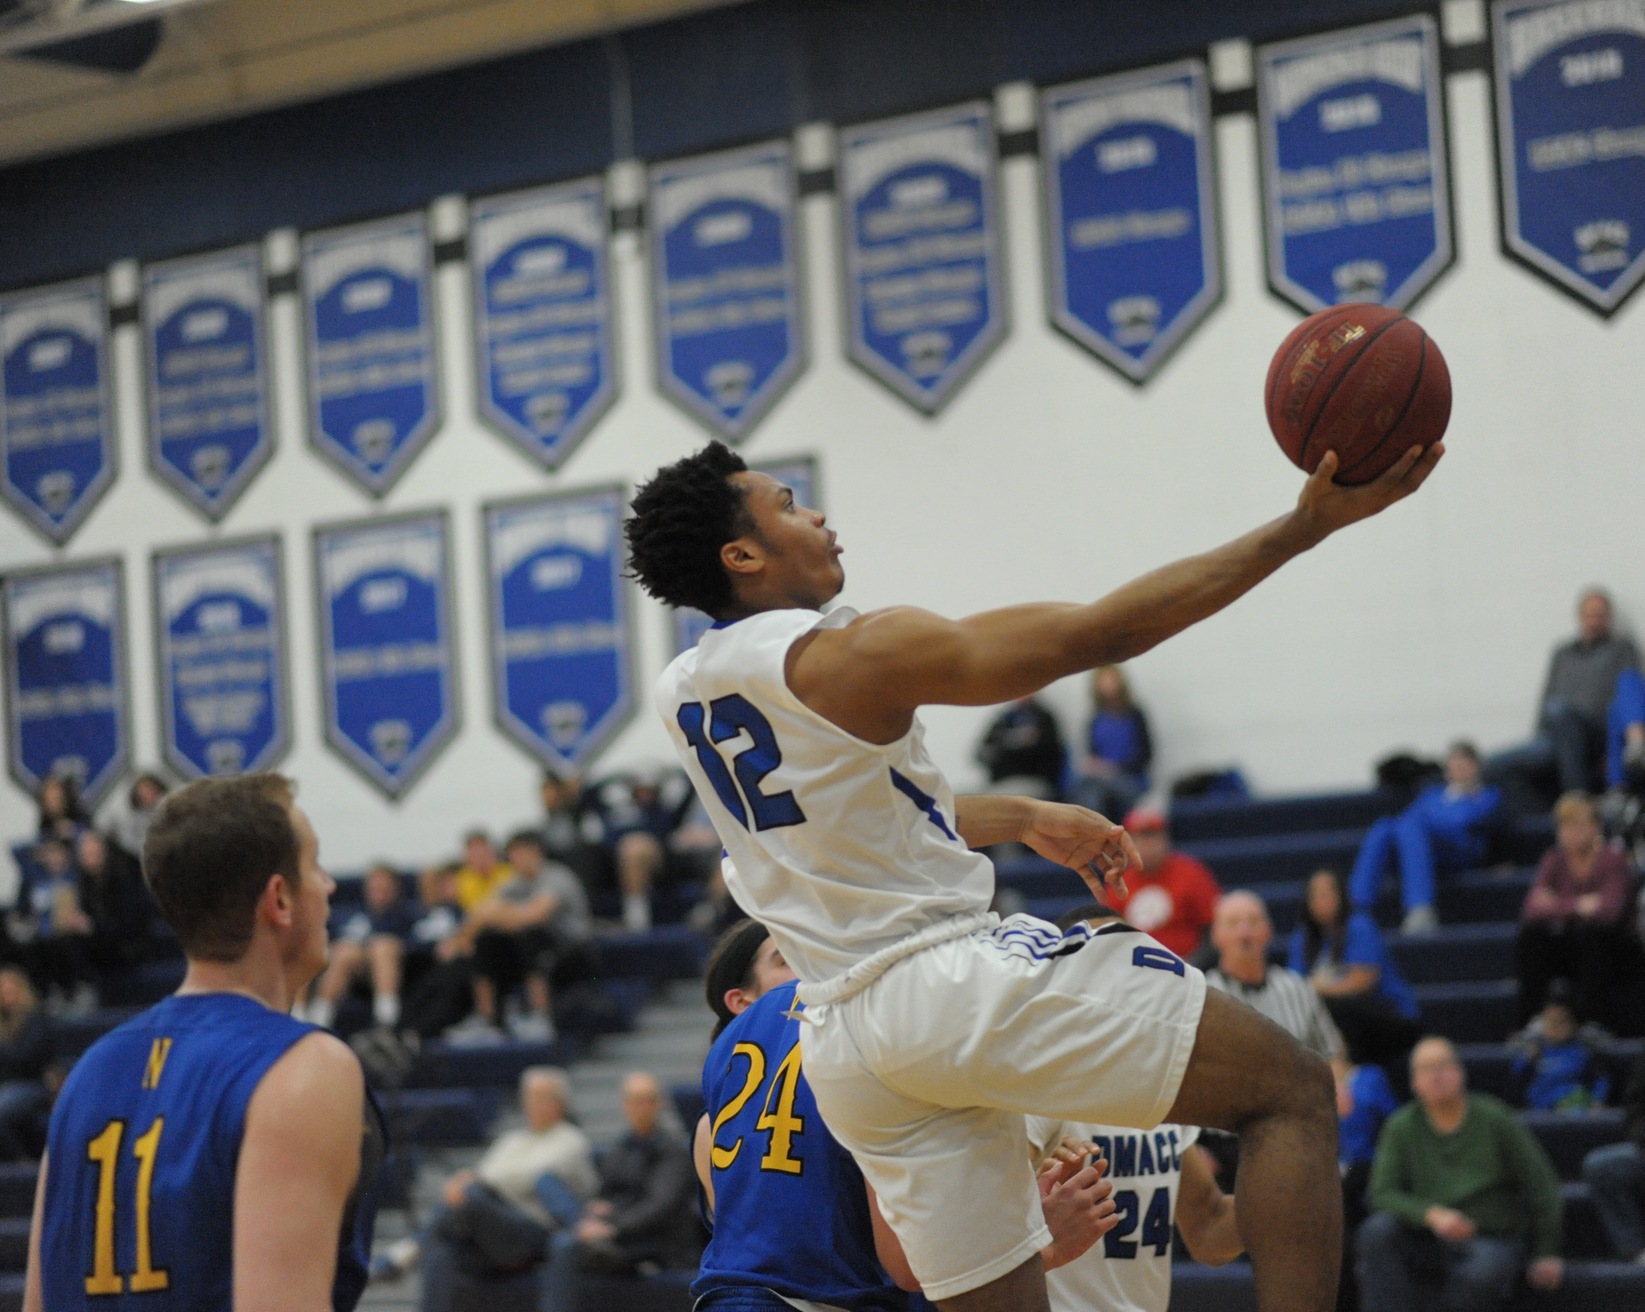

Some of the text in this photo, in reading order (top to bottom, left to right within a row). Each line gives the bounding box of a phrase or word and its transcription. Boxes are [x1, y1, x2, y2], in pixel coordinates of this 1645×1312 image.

[676, 692, 808, 834] 12
[141, 1036, 174, 1091] N
[710, 1040, 805, 1177] 24
[1091, 1129, 1182, 1178] DMACC
[85, 1117, 171, 1296] 11
[1103, 1186, 1172, 1260] 24
